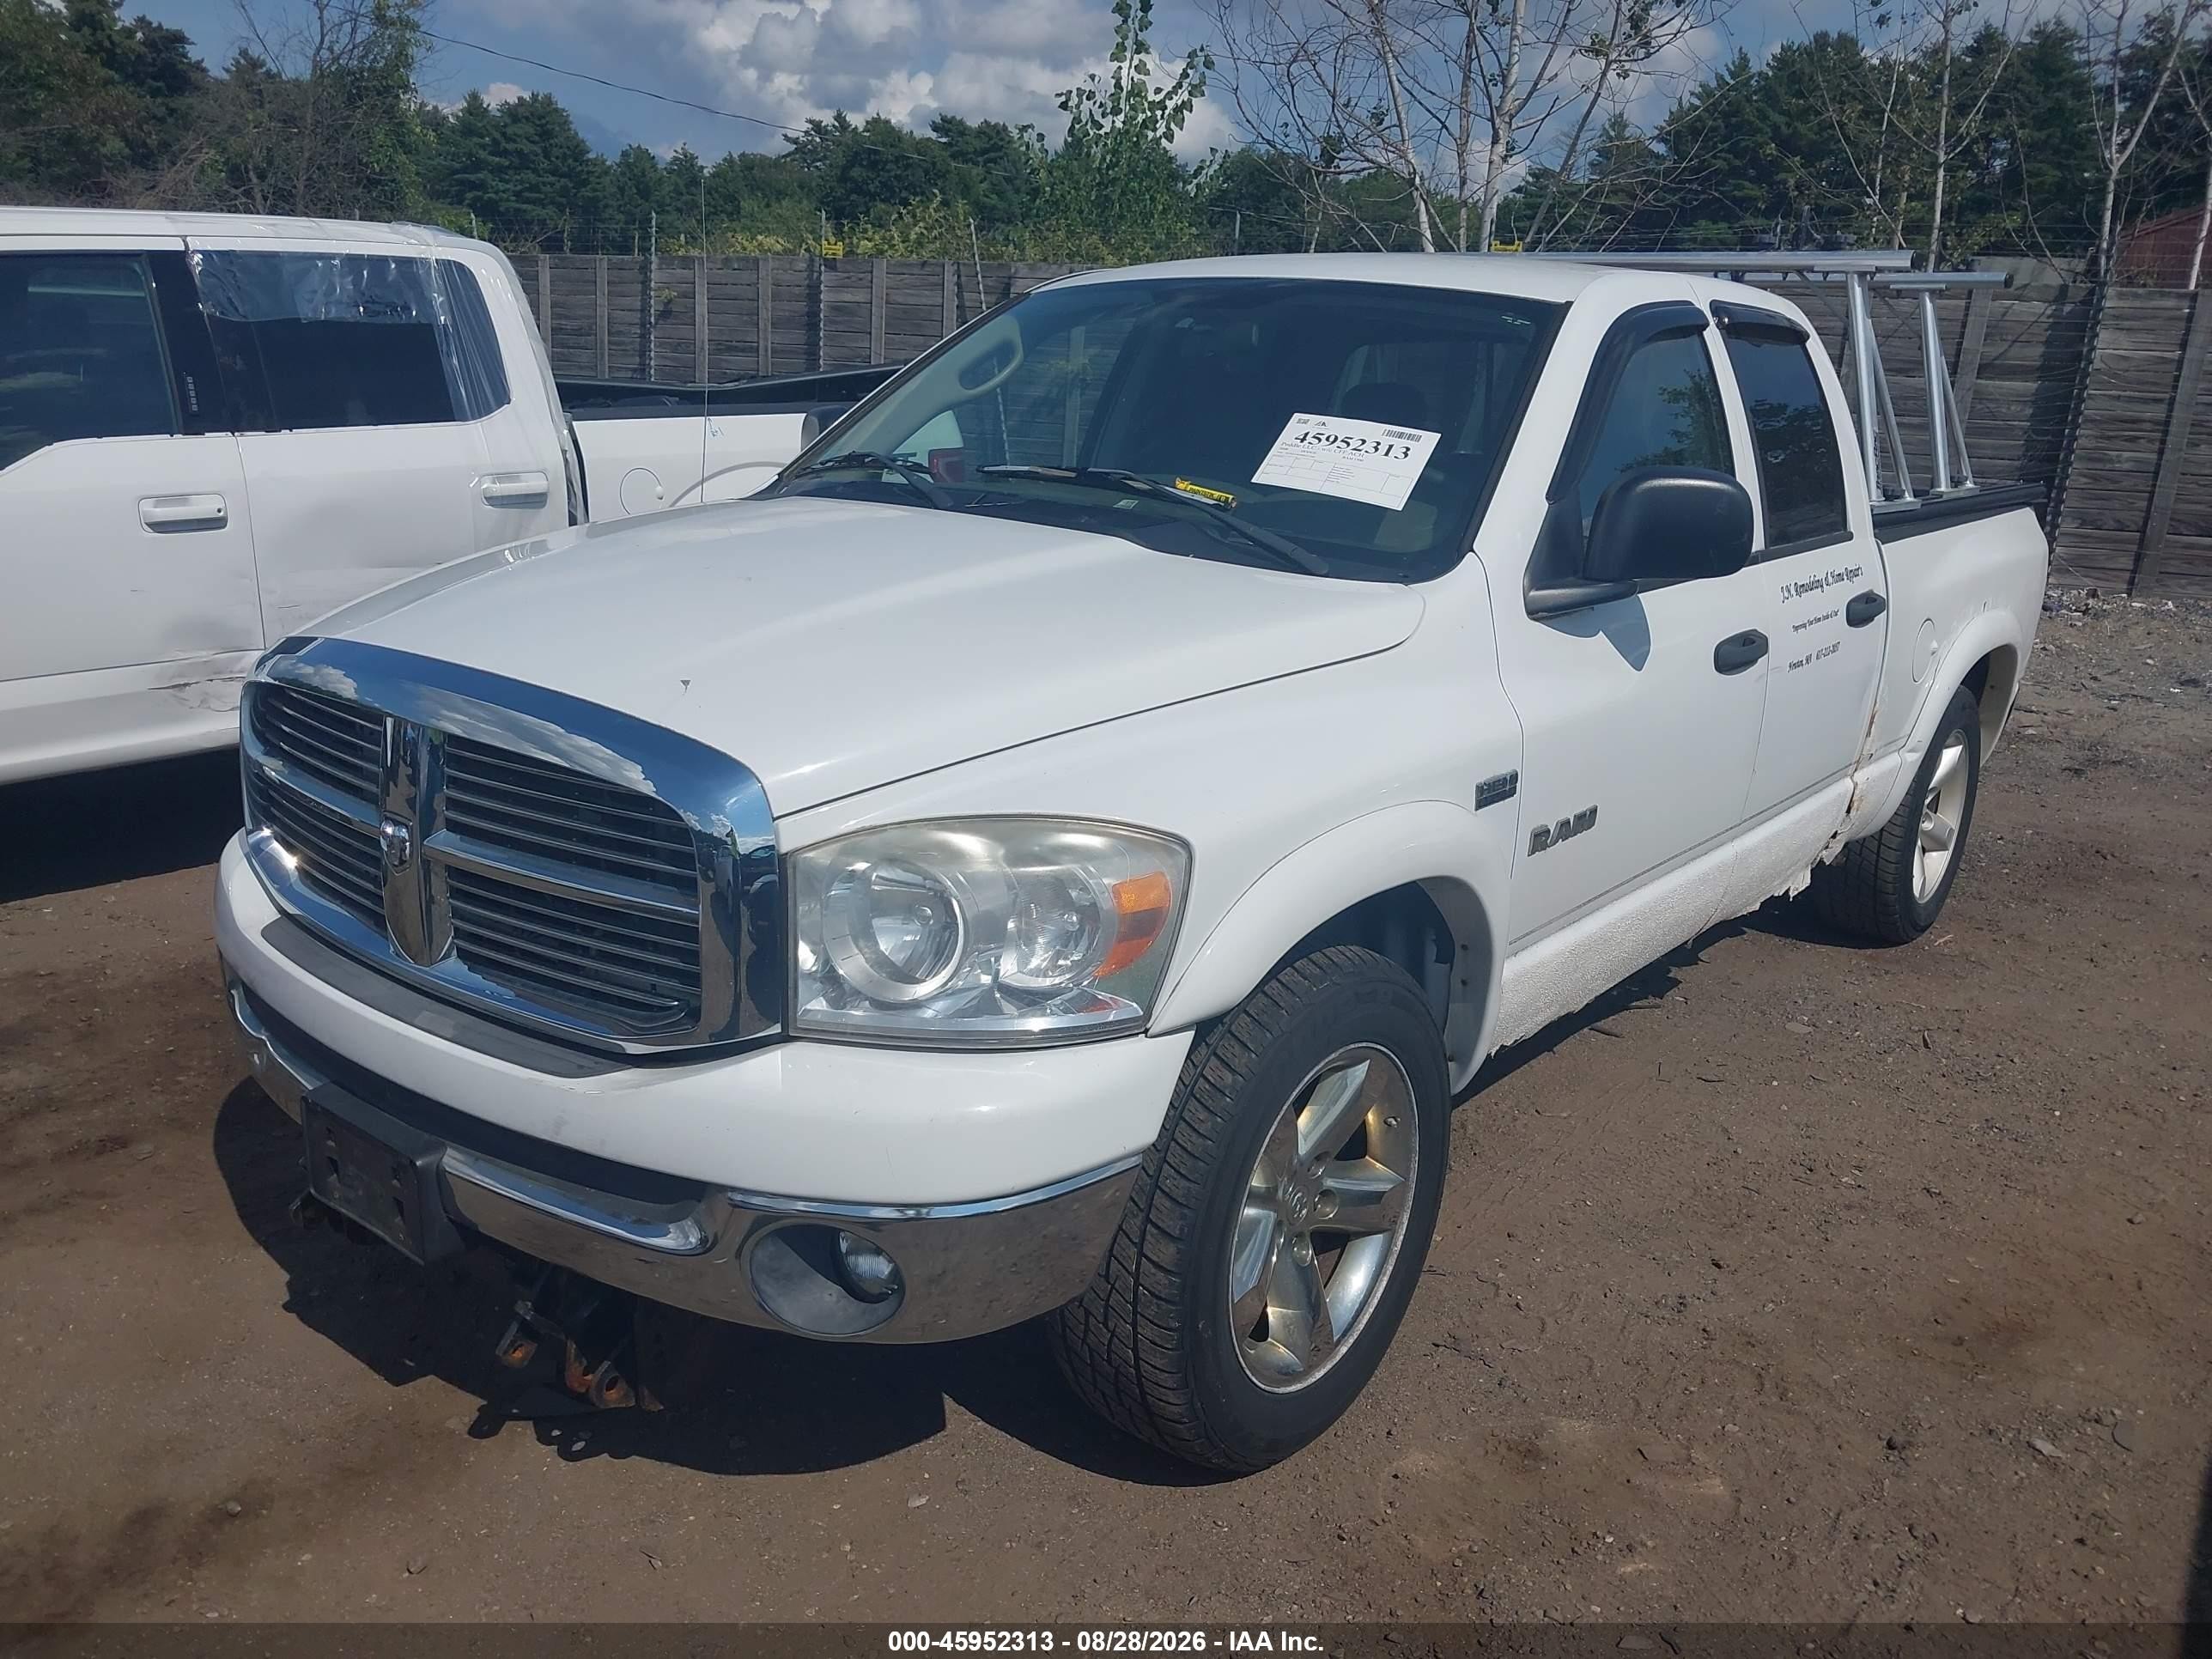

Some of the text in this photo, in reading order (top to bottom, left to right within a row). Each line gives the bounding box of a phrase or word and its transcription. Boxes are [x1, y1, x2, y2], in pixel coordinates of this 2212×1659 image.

[1293, 430, 1412, 461] 45952313
[1794, 574, 1825, 598] Remodeling
[1830, 569, 1844, 586] Home
[1527, 804, 1599, 857] RAM
